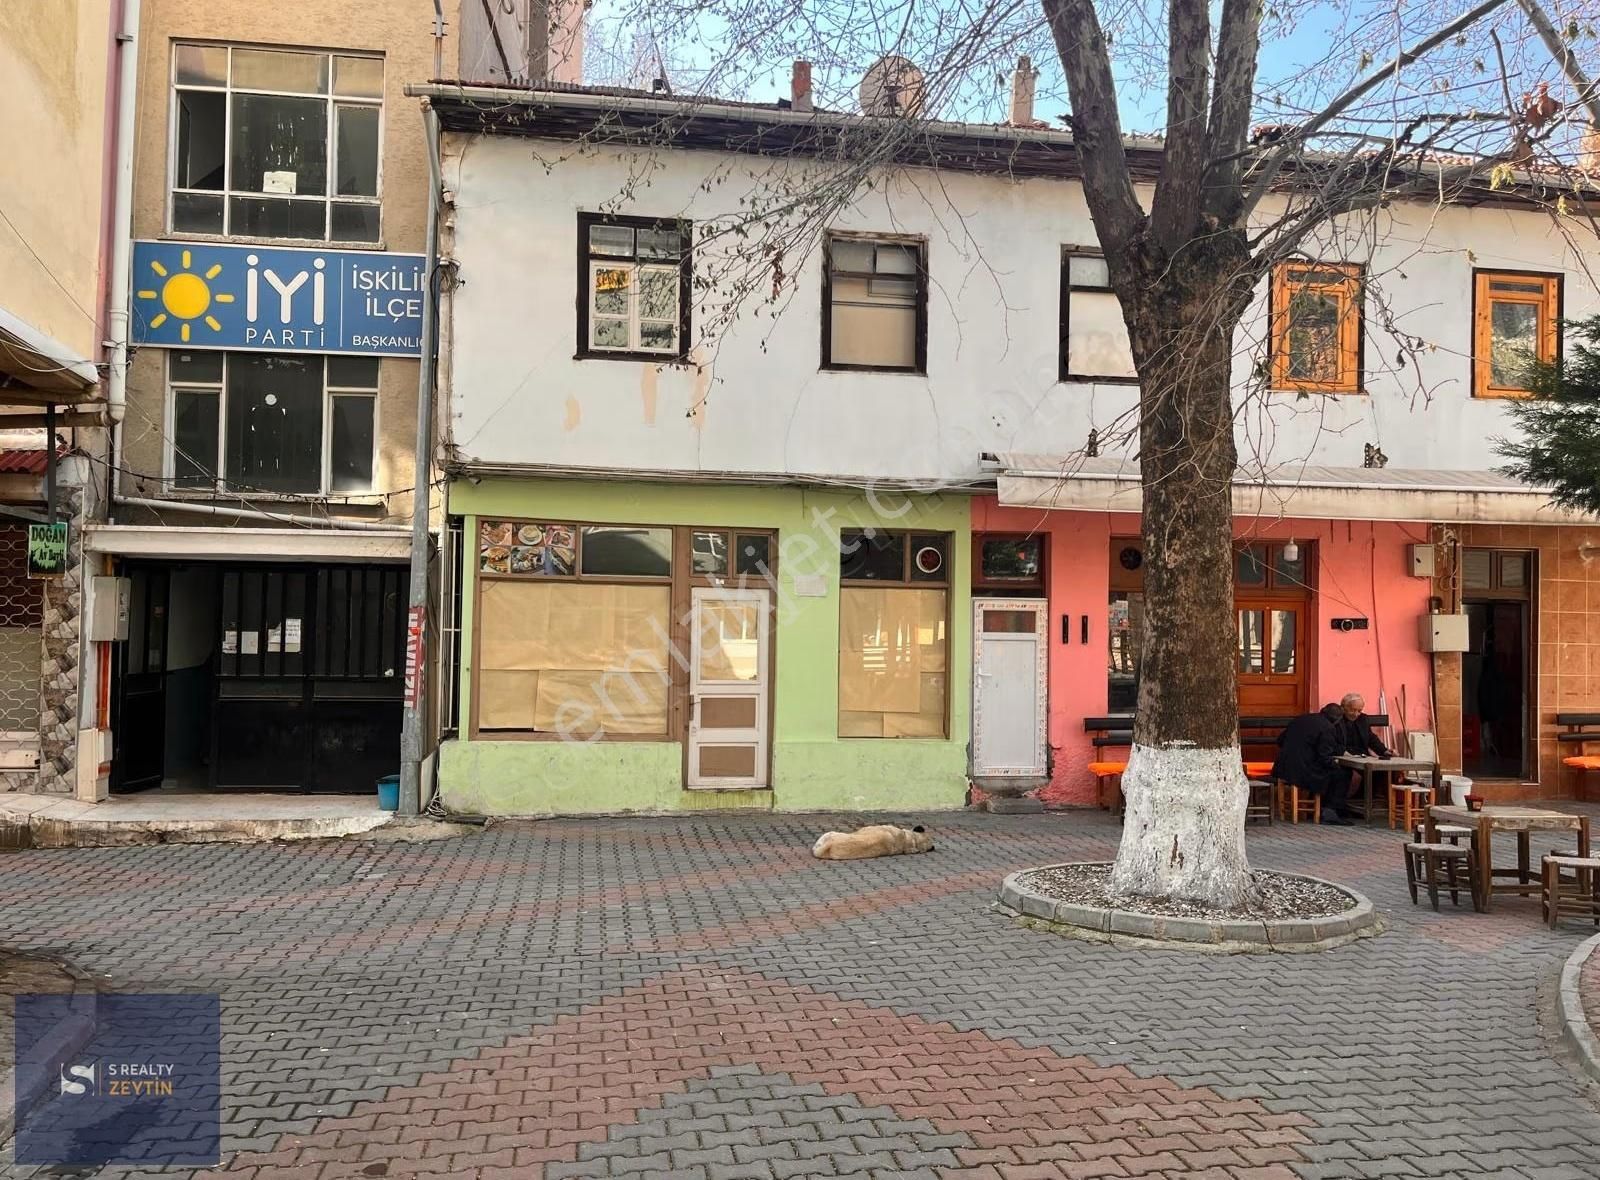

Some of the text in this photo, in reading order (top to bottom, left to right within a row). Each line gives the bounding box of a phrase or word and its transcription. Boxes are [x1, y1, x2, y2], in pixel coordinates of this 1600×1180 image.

[246, 254, 326, 326] İYİ
[366, 291, 421, 323] İLÇE
[245, 328, 325, 347] PARTİ
